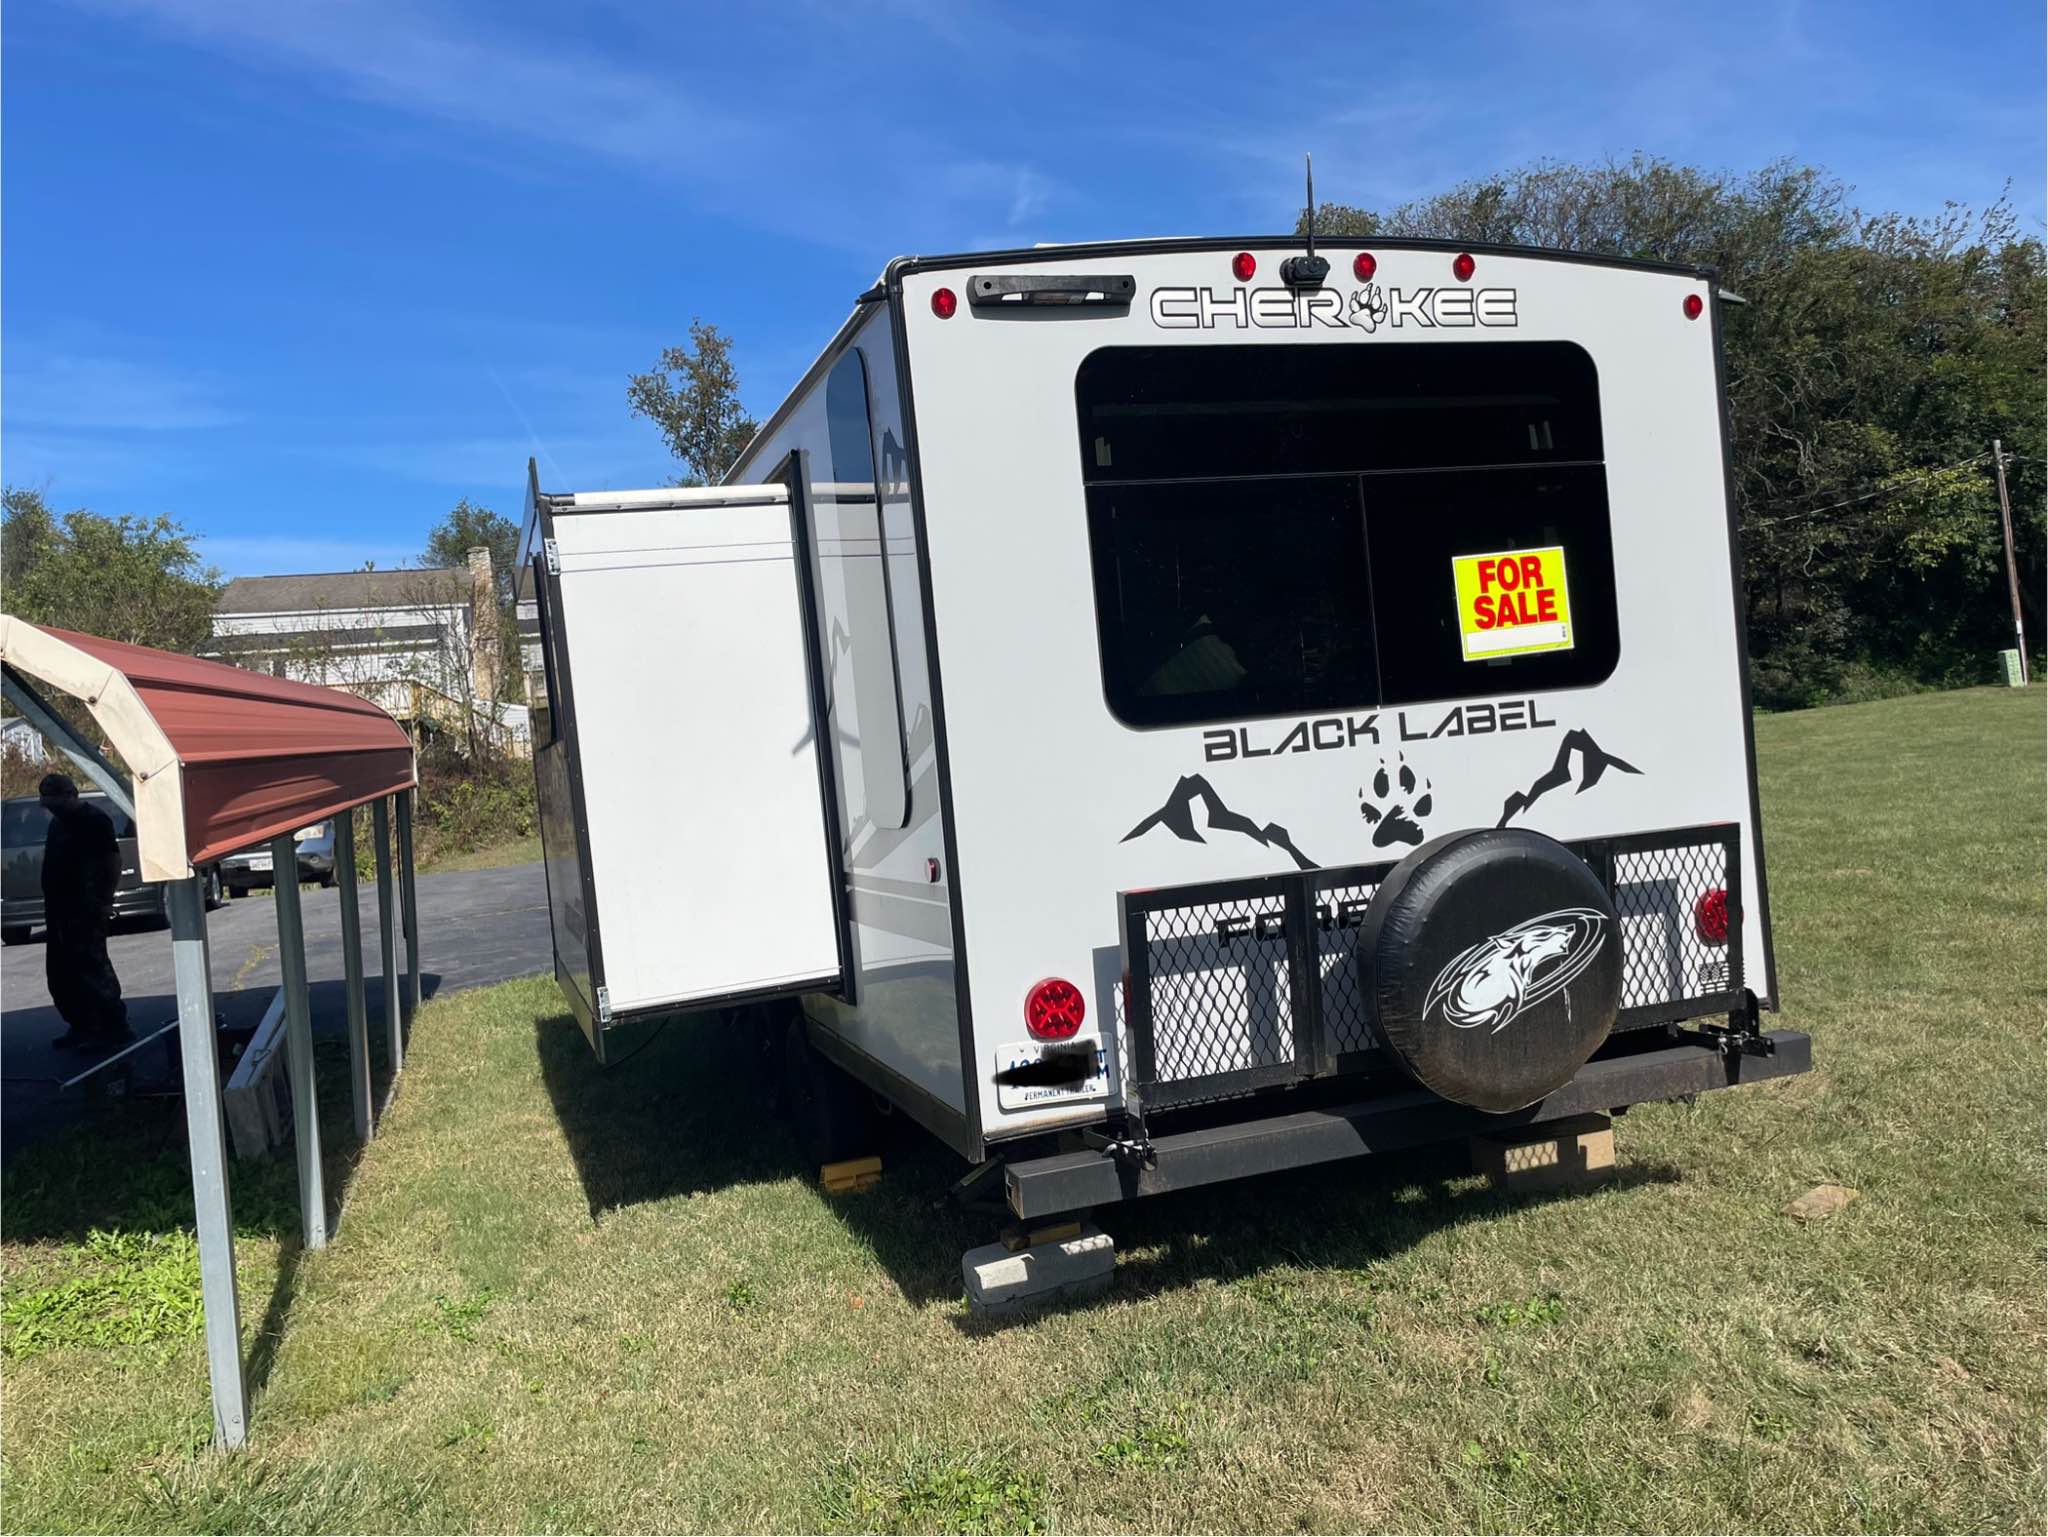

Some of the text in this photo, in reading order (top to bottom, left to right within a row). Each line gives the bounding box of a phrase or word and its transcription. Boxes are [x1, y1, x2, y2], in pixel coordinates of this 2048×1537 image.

[1477, 555, 1544, 593] FOR
[1473, 588, 1558, 630] SALE
[1203, 700, 1556, 762] BLACK LABEL
